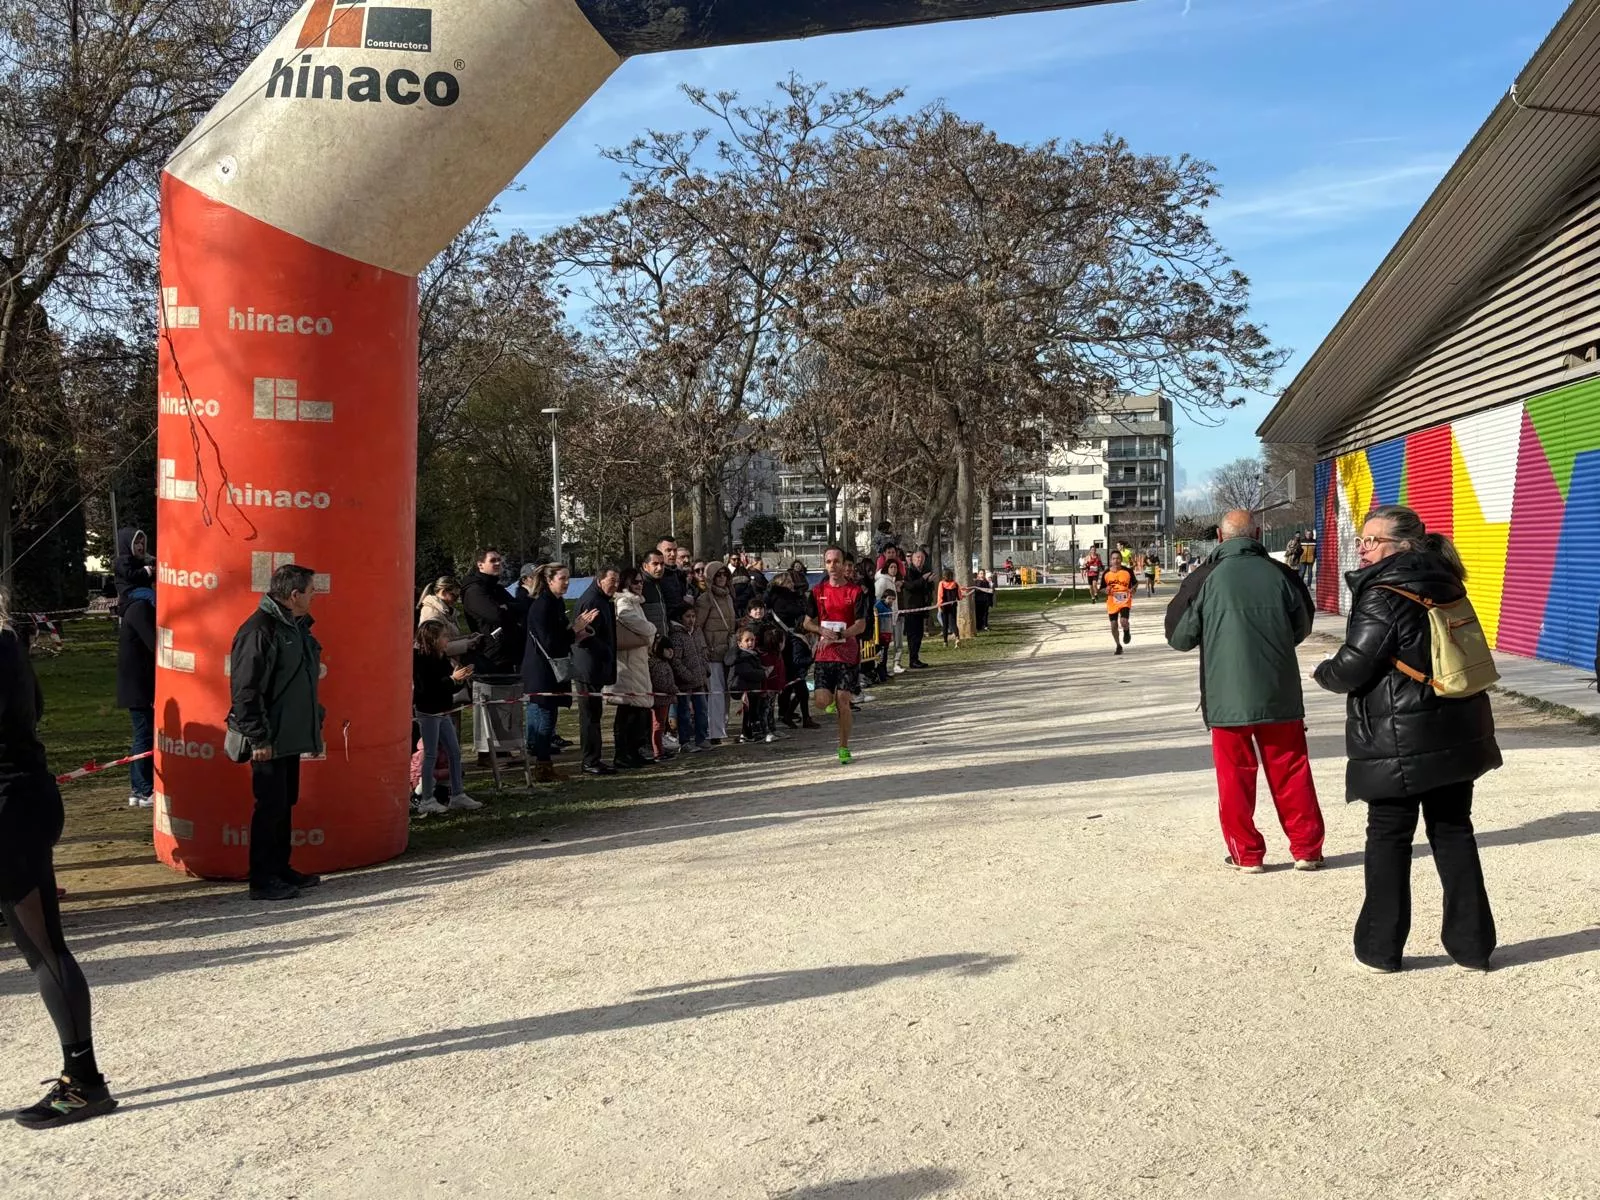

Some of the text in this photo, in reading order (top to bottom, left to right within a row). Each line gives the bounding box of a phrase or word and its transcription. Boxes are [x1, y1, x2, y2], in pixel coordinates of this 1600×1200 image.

[366, 39, 429, 50] Constructora
[265, 54, 460, 107] hinaco
[228, 306, 334, 336] hinaco
[160, 391, 220, 417] hinaco
[225, 483, 331, 509] hinaco
[158, 561, 219, 590] hinaco
[222, 822, 325, 846] hico
